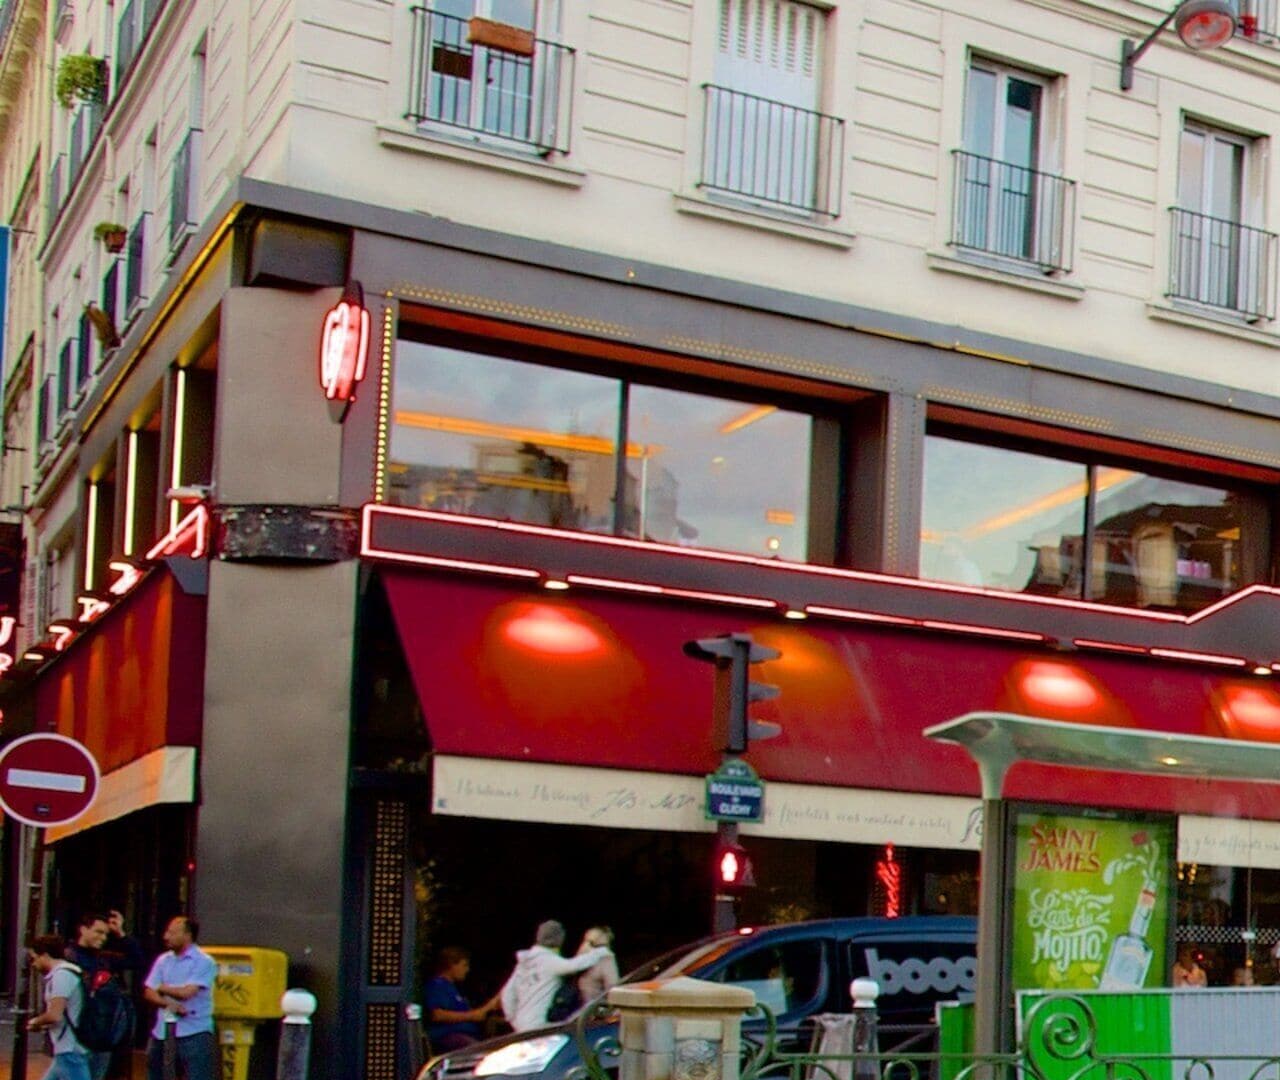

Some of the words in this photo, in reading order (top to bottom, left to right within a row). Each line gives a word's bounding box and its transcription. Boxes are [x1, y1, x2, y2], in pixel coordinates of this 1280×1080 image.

[710, 783, 762, 797] BOULEVARD
[719, 802, 752, 816] CLICHY
[1028, 823, 1098, 849] SAINT
[1020, 848, 1101, 873] JAMES
